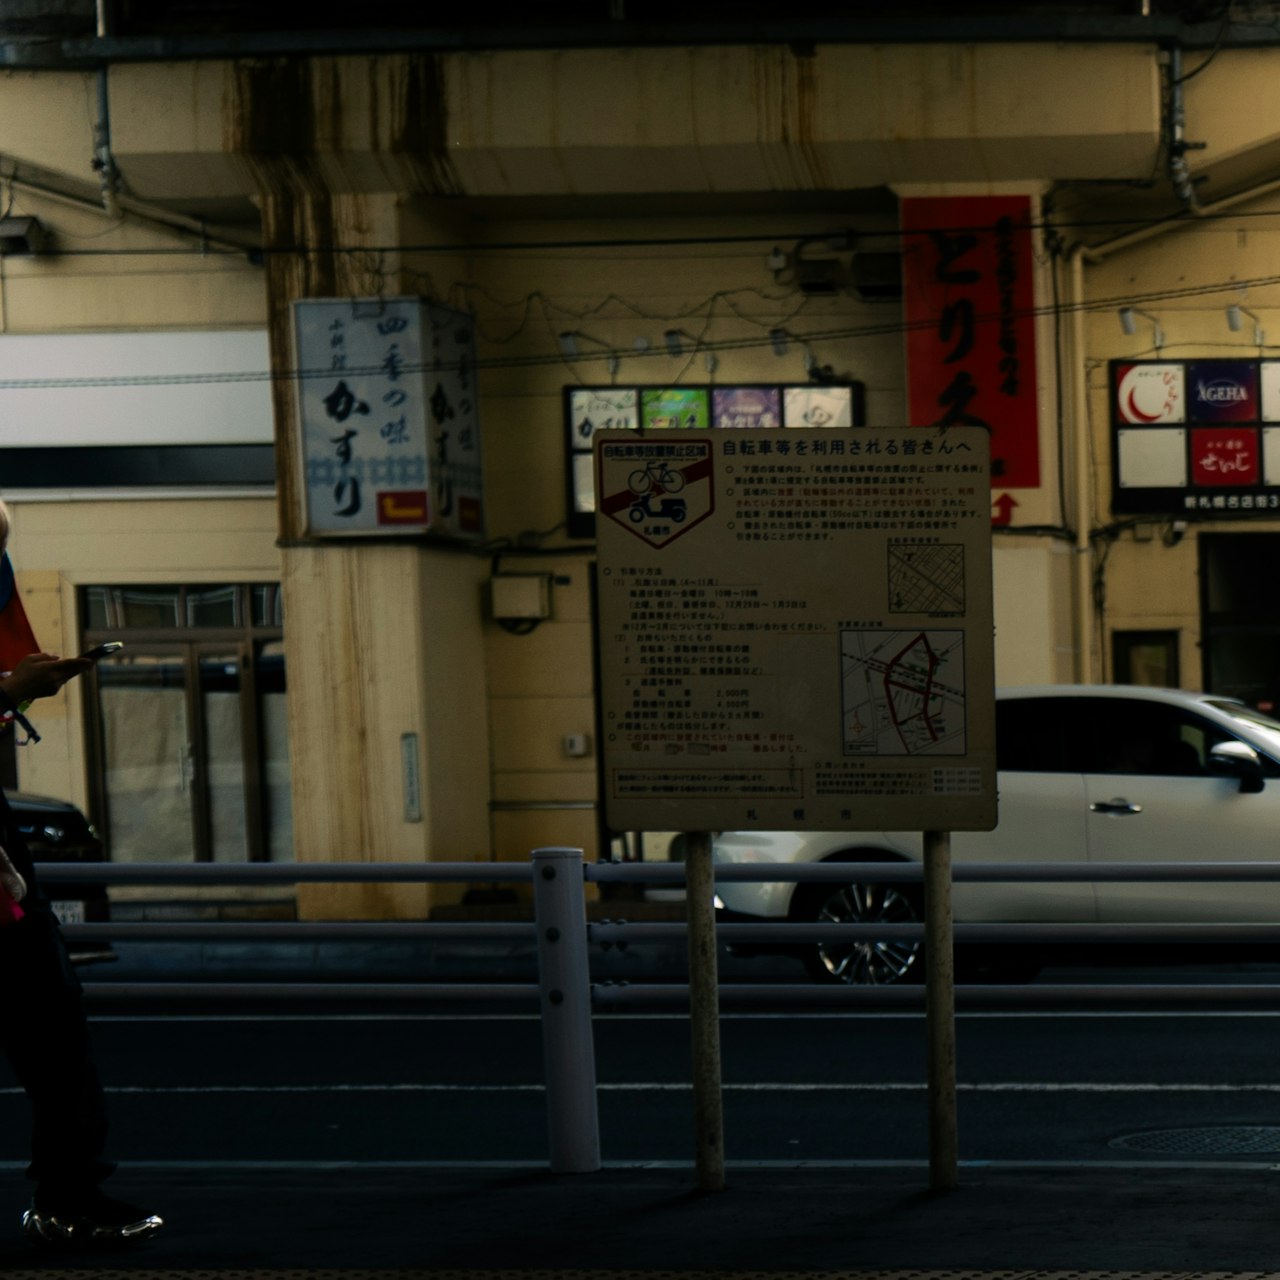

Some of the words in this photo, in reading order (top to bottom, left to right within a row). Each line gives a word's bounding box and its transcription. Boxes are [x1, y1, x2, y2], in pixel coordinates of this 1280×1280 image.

[1197, 381, 1248, 402] AGEHA
[723, 439, 972, 456] 自転車等を利用される皆さんへ
